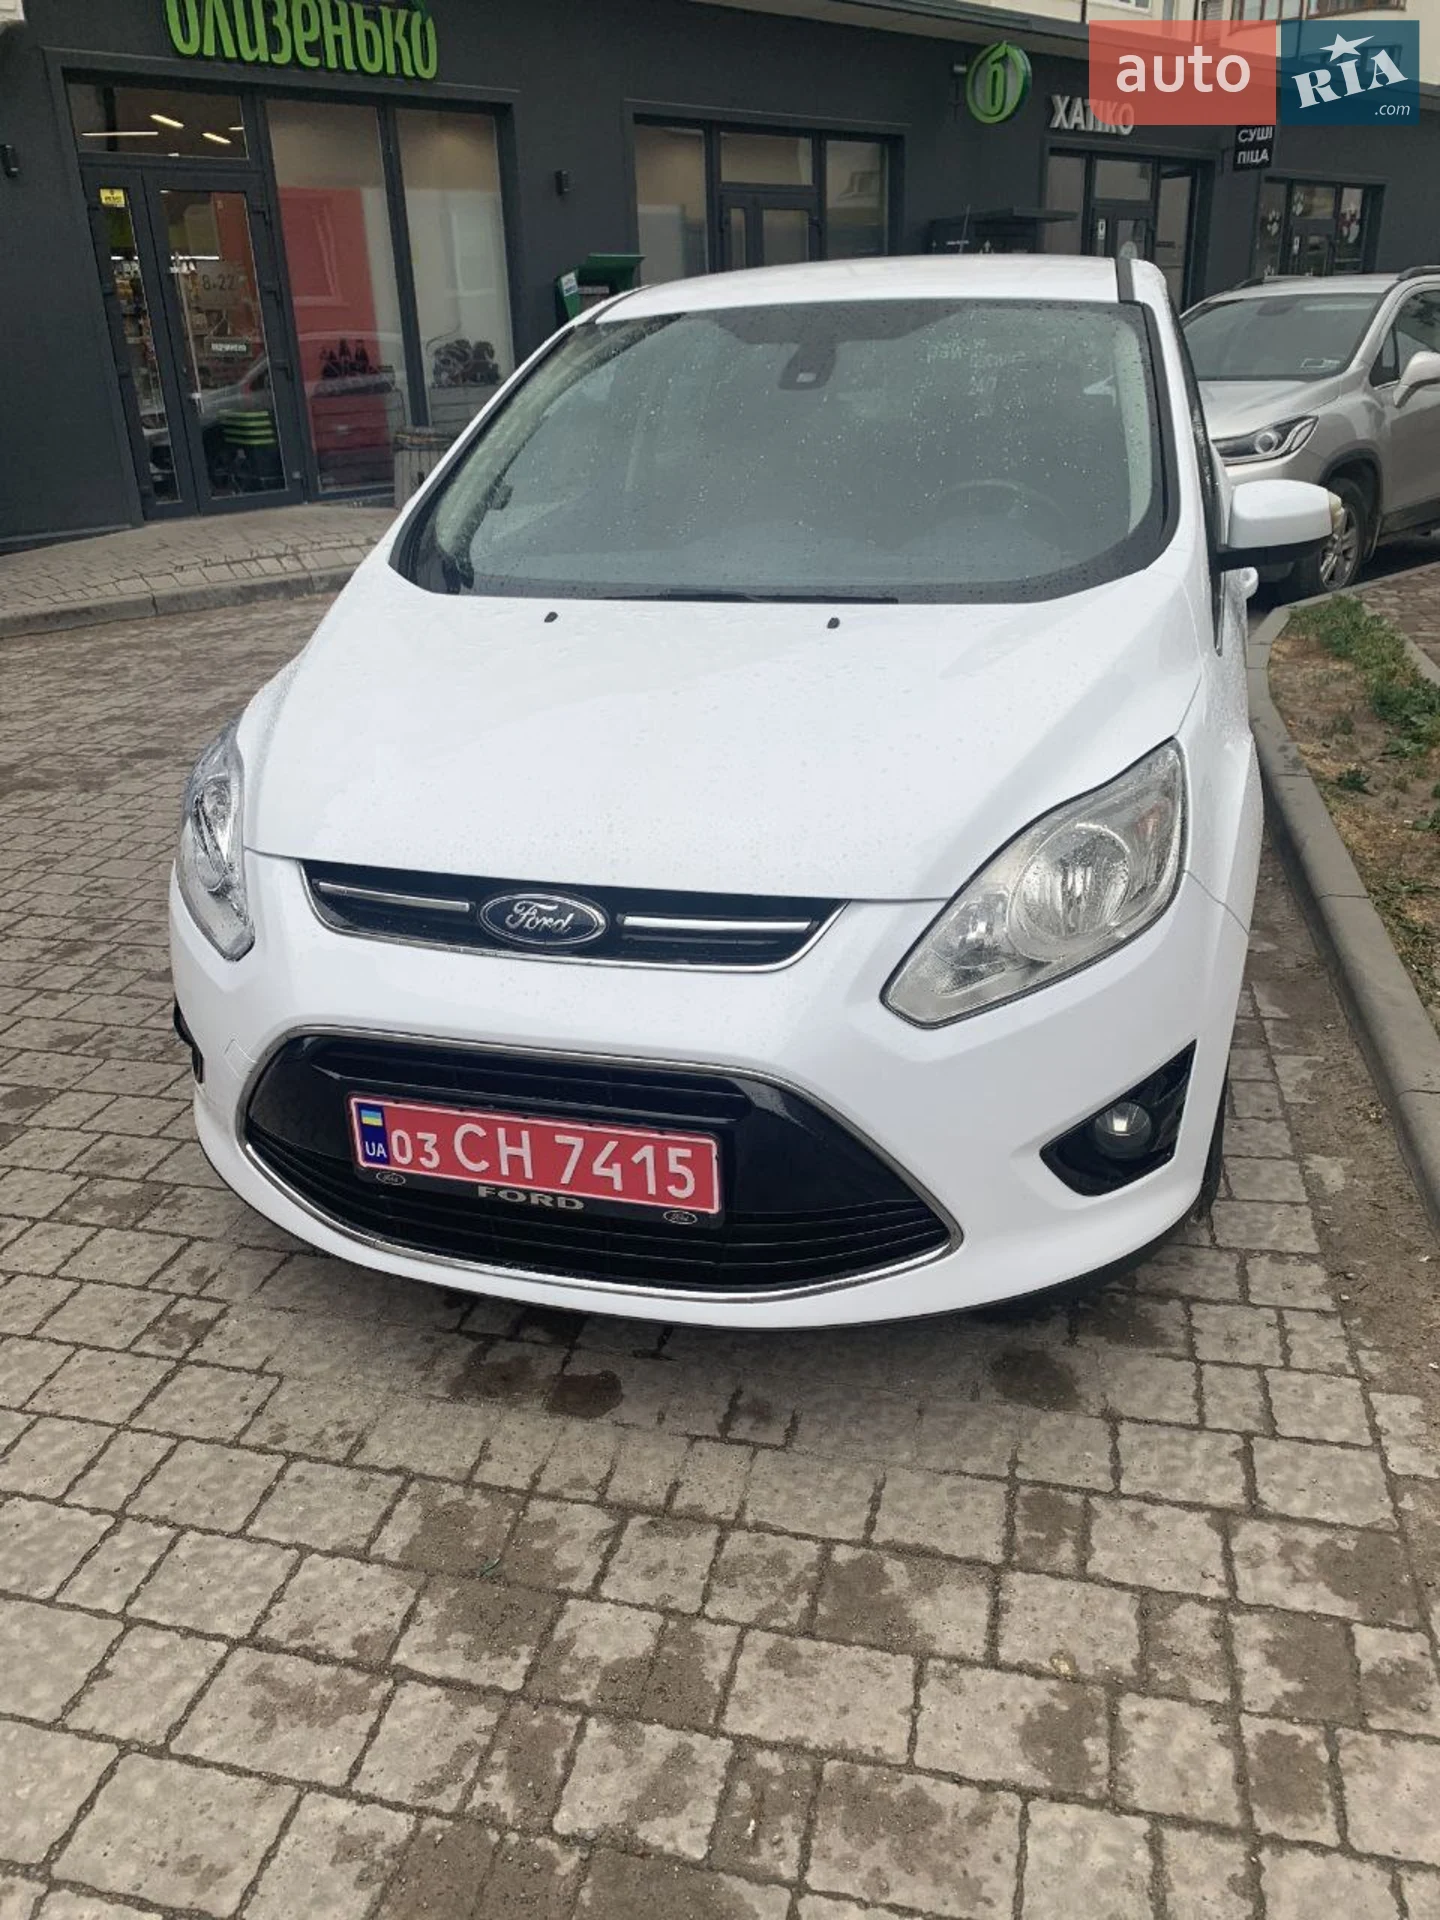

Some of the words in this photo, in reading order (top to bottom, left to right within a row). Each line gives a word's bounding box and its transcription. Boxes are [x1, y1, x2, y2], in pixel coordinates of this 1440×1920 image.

[1237, 148, 1269, 164] ПІЦА
[505, 901, 574, 933] Ford
[365, 1141, 388, 1158] UA
[391, 1129, 441, 1170] 03
[453, 1123, 534, 1180] CH
[555, 1135, 696, 1199] 7415
[478, 1186, 584, 1209] FORD
